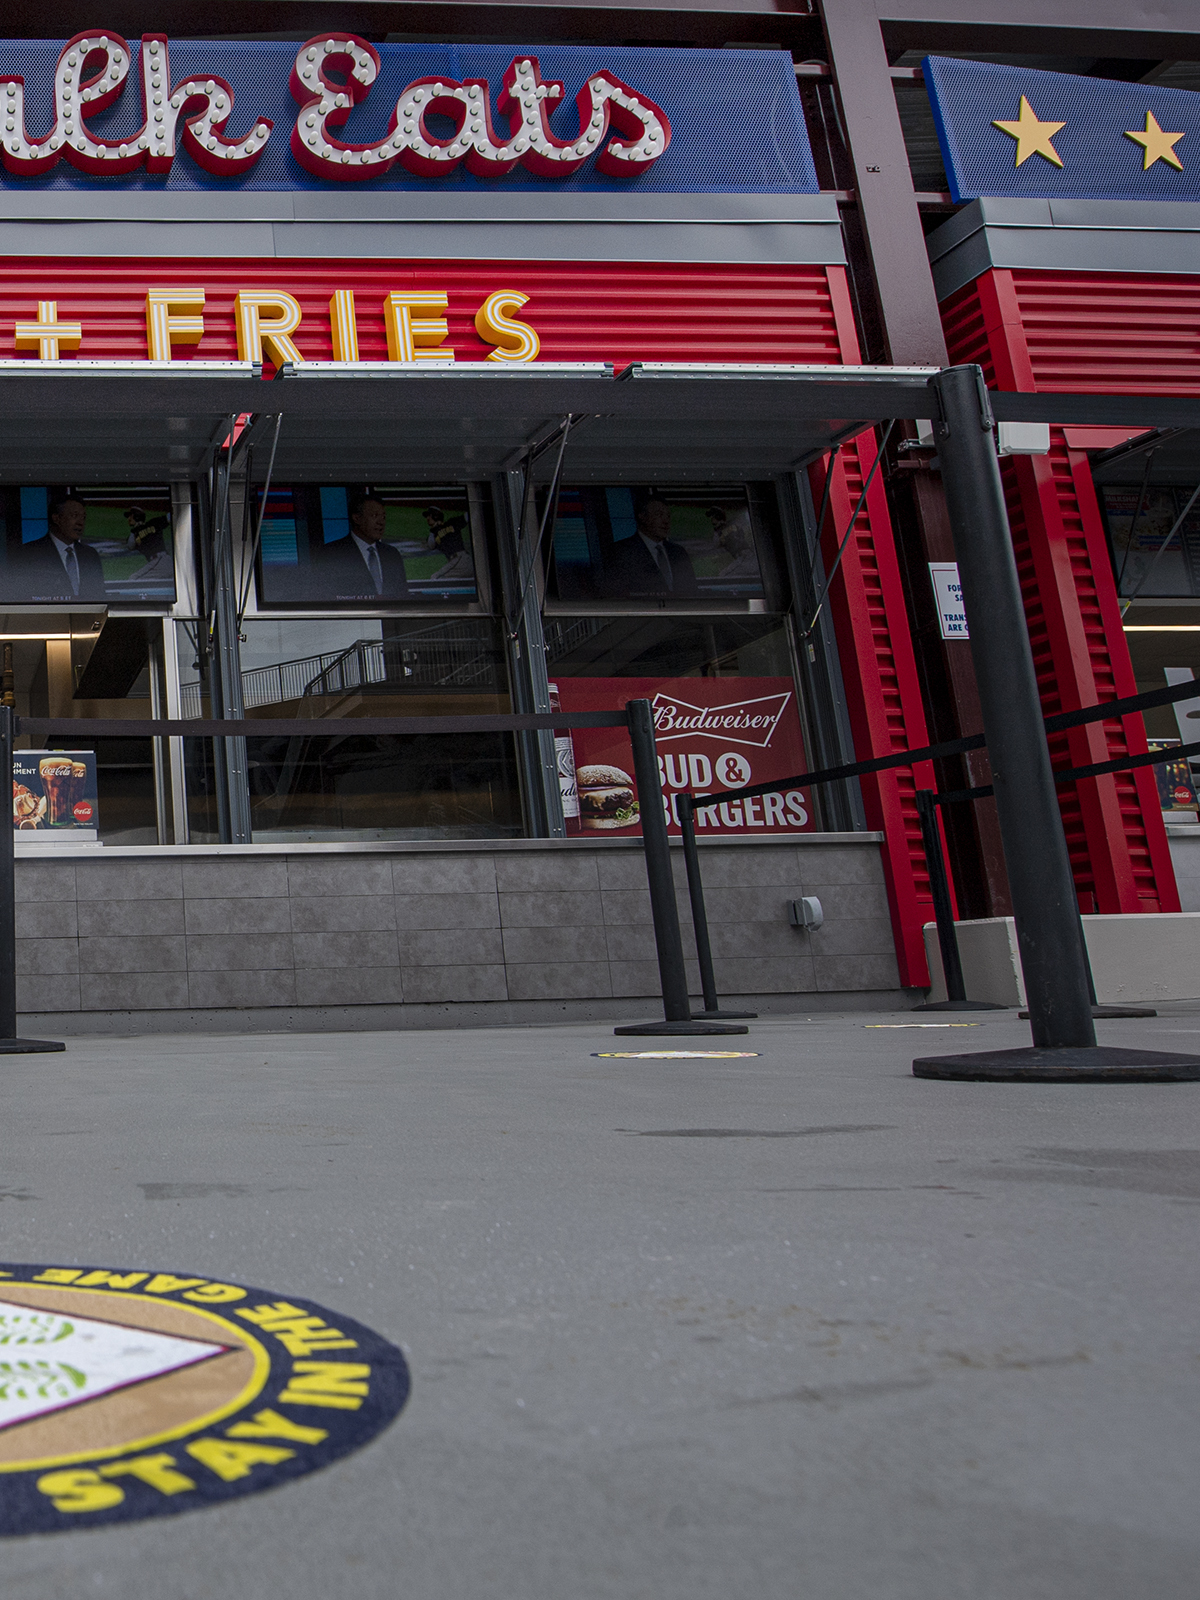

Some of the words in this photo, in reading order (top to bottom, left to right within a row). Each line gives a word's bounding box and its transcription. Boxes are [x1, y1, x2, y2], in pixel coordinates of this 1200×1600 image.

[290, 32, 672, 181] Eats
[146, 288, 540, 367] FRIES
[652, 704, 779, 732] Budweiser
[32, 1268, 247, 1303] GAME
[234, 1301, 358, 1357] THE
[278, 1360, 372, 1411] IN
[37, 1409, 329, 1513] STAY
